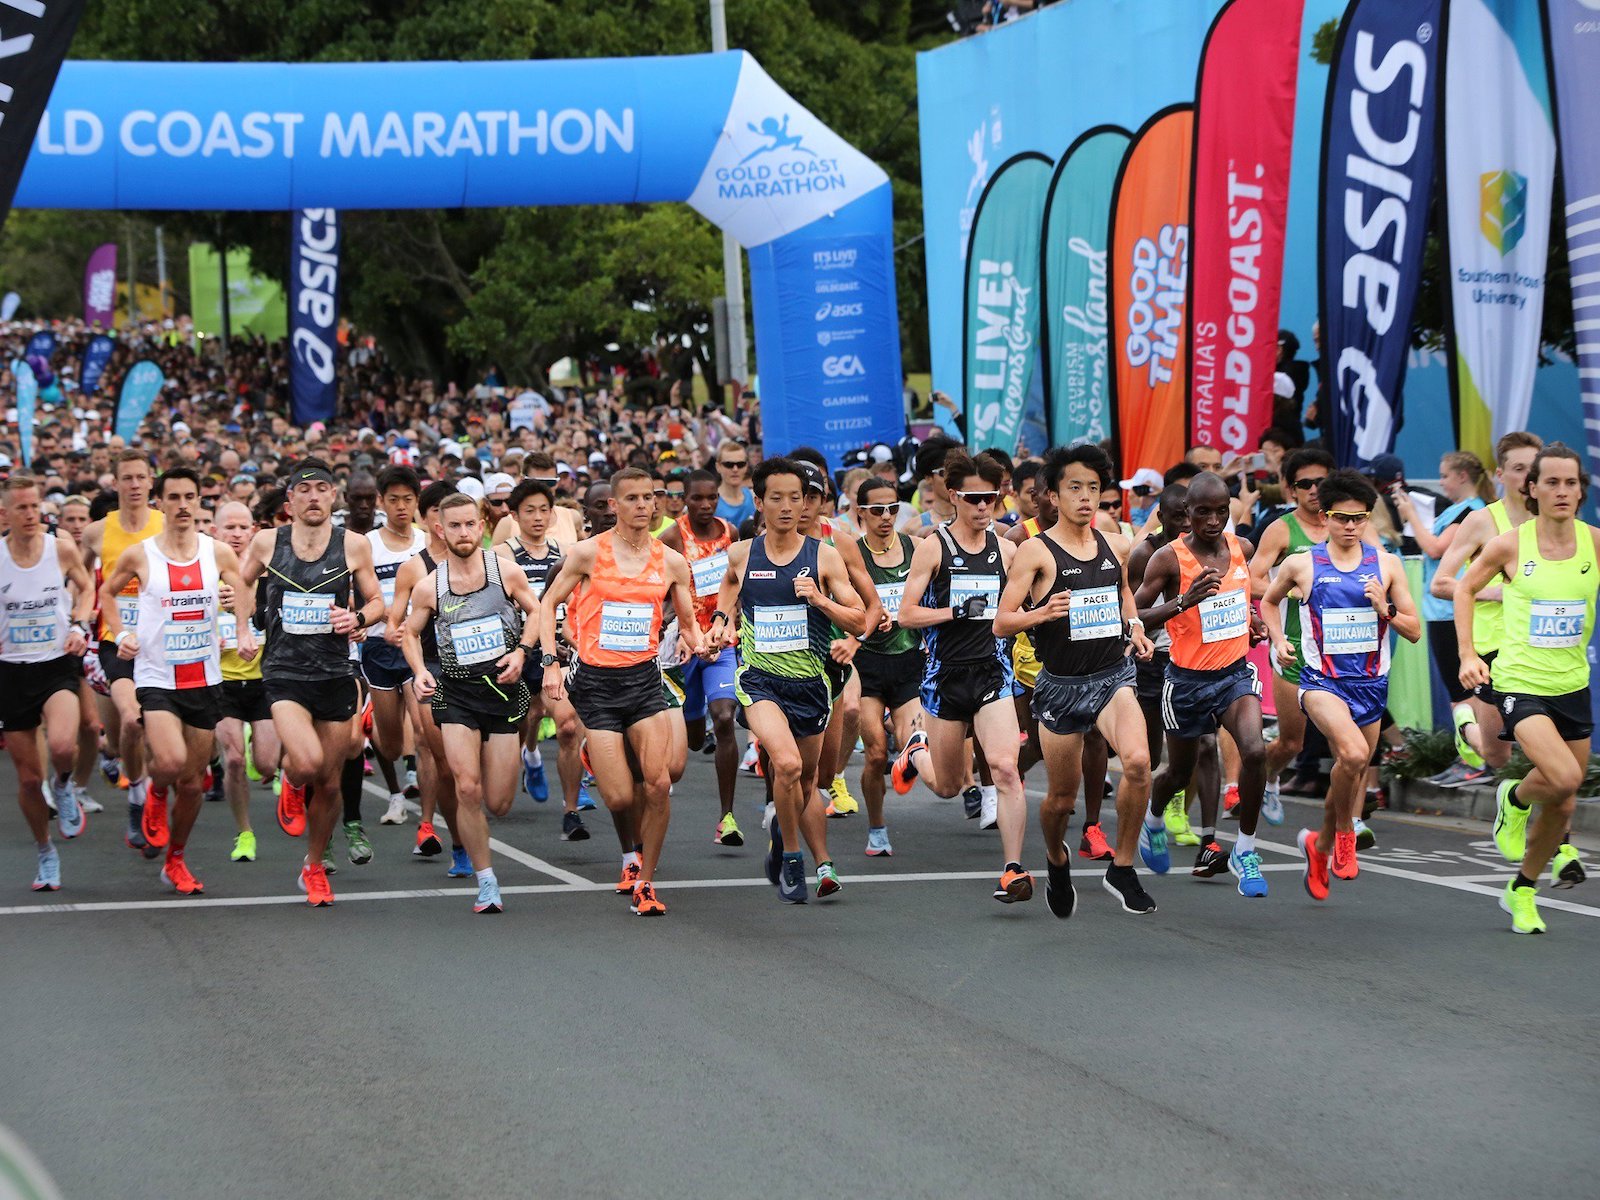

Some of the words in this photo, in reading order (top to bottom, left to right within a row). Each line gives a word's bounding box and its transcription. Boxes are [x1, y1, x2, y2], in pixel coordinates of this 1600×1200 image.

[37, 109, 104, 156] LD
[119, 109, 304, 158] COAST
[319, 107, 634, 159] MARATHON
[716, 165, 771, 182] GOLD
[778, 159, 839, 177] COAST
[718, 174, 846, 199] MARATHON
[1126, 236, 1158, 367] GOOD
[1148, 223, 1189, 388] TIMES
[974, 259, 1015, 390] LIVE!
[1064, 237, 1107, 446] ueensland
[996, 276, 1032, 436] ueensland
[822, 354, 865, 377] GCA
[1197, 321, 1217, 444] STRALIA'S
[822, 395, 869, 407] GARMIN
[824, 416, 872, 431] CITIZEN
[1061, 567, 1083, 576] GMO
[23, 597, 57, 610] ZEALAND
[161, 594, 212, 607] intraining
[1083, 594, 1109, 605] PACER
[1213, 597, 1236, 609] PACER
[284, 608, 328, 623] CHARLIE
[775, 613, 784, 621] 17
[1071, 606, 1116, 626] SHIMODA
[1203, 608, 1244, 629] KIPLAGAT
[1555, 607, 1565, 615] 29
[13, 626, 51, 643] NICK
[602, 619, 646, 633] EGGLESTON
[755, 624, 801, 639] YAMAZAKI
[1325, 626, 1372, 640] FUJIKAWA
[1534, 617, 1576, 635] JACK
[166, 632, 206, 650] AIDAN
[456, 635, 498, 653] RIDLEY
